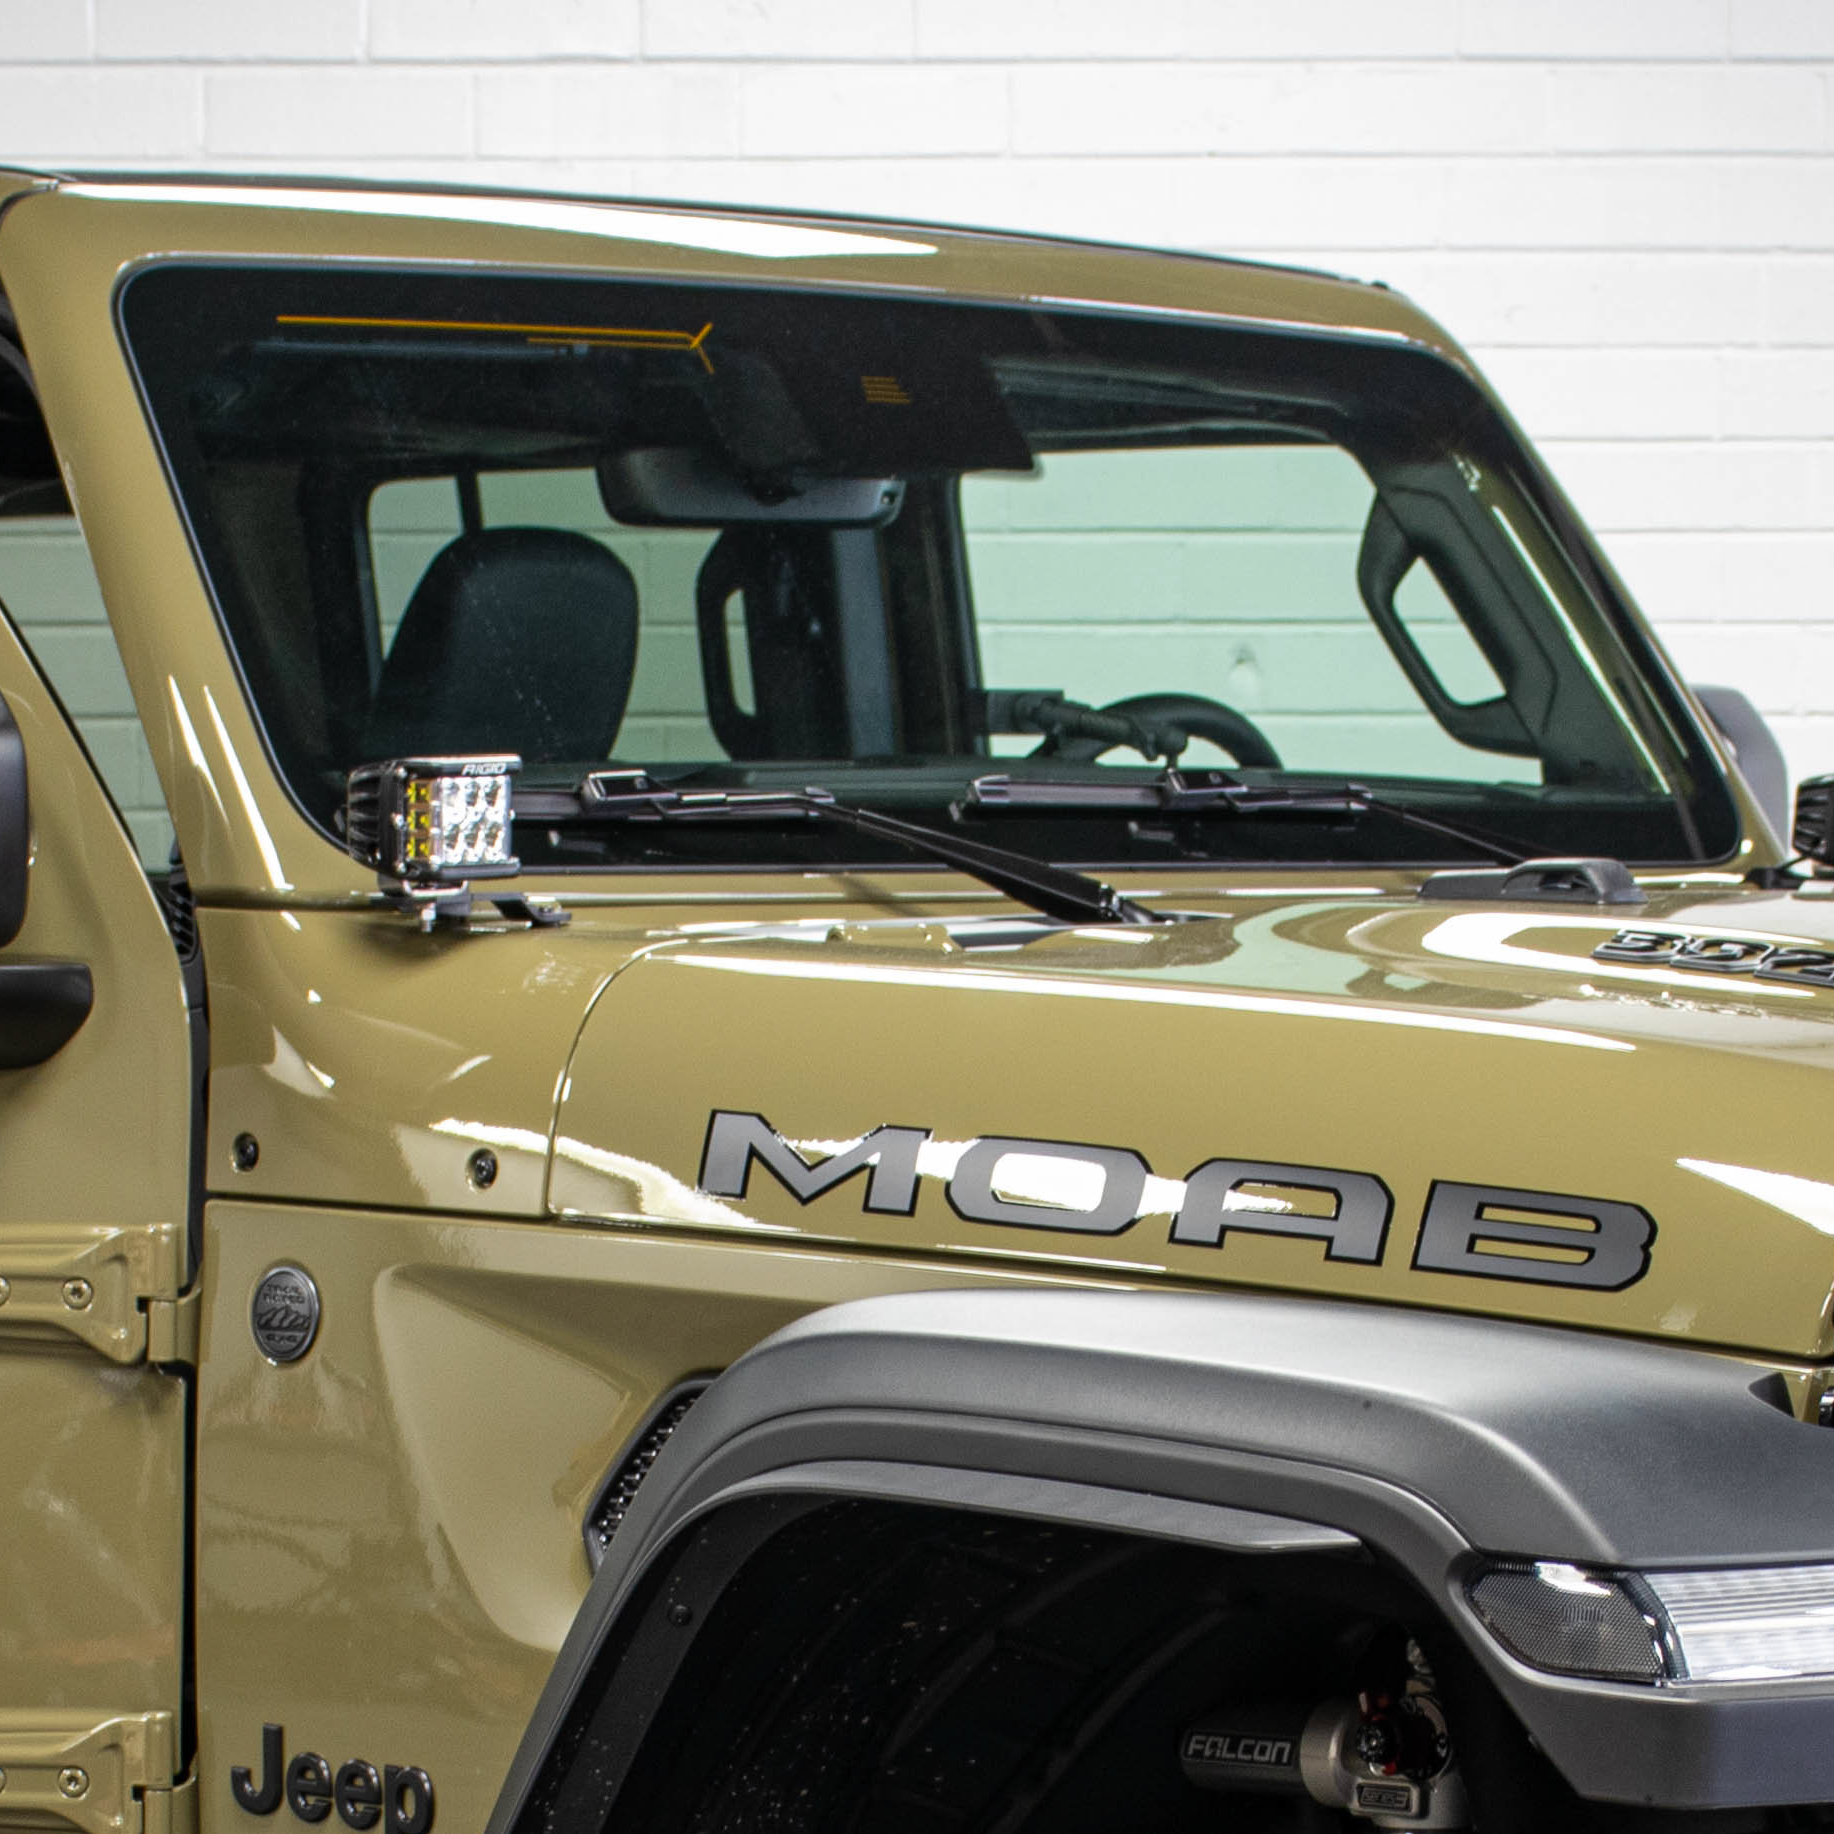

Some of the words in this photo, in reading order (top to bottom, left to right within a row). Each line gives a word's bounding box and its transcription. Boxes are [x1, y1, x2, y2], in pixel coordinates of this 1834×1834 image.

[462, 762, 507, 776] RIGID
[696, 1108, 1659, 1292] MOAB
[1187, 1735, 1291, 1764] FALCON
